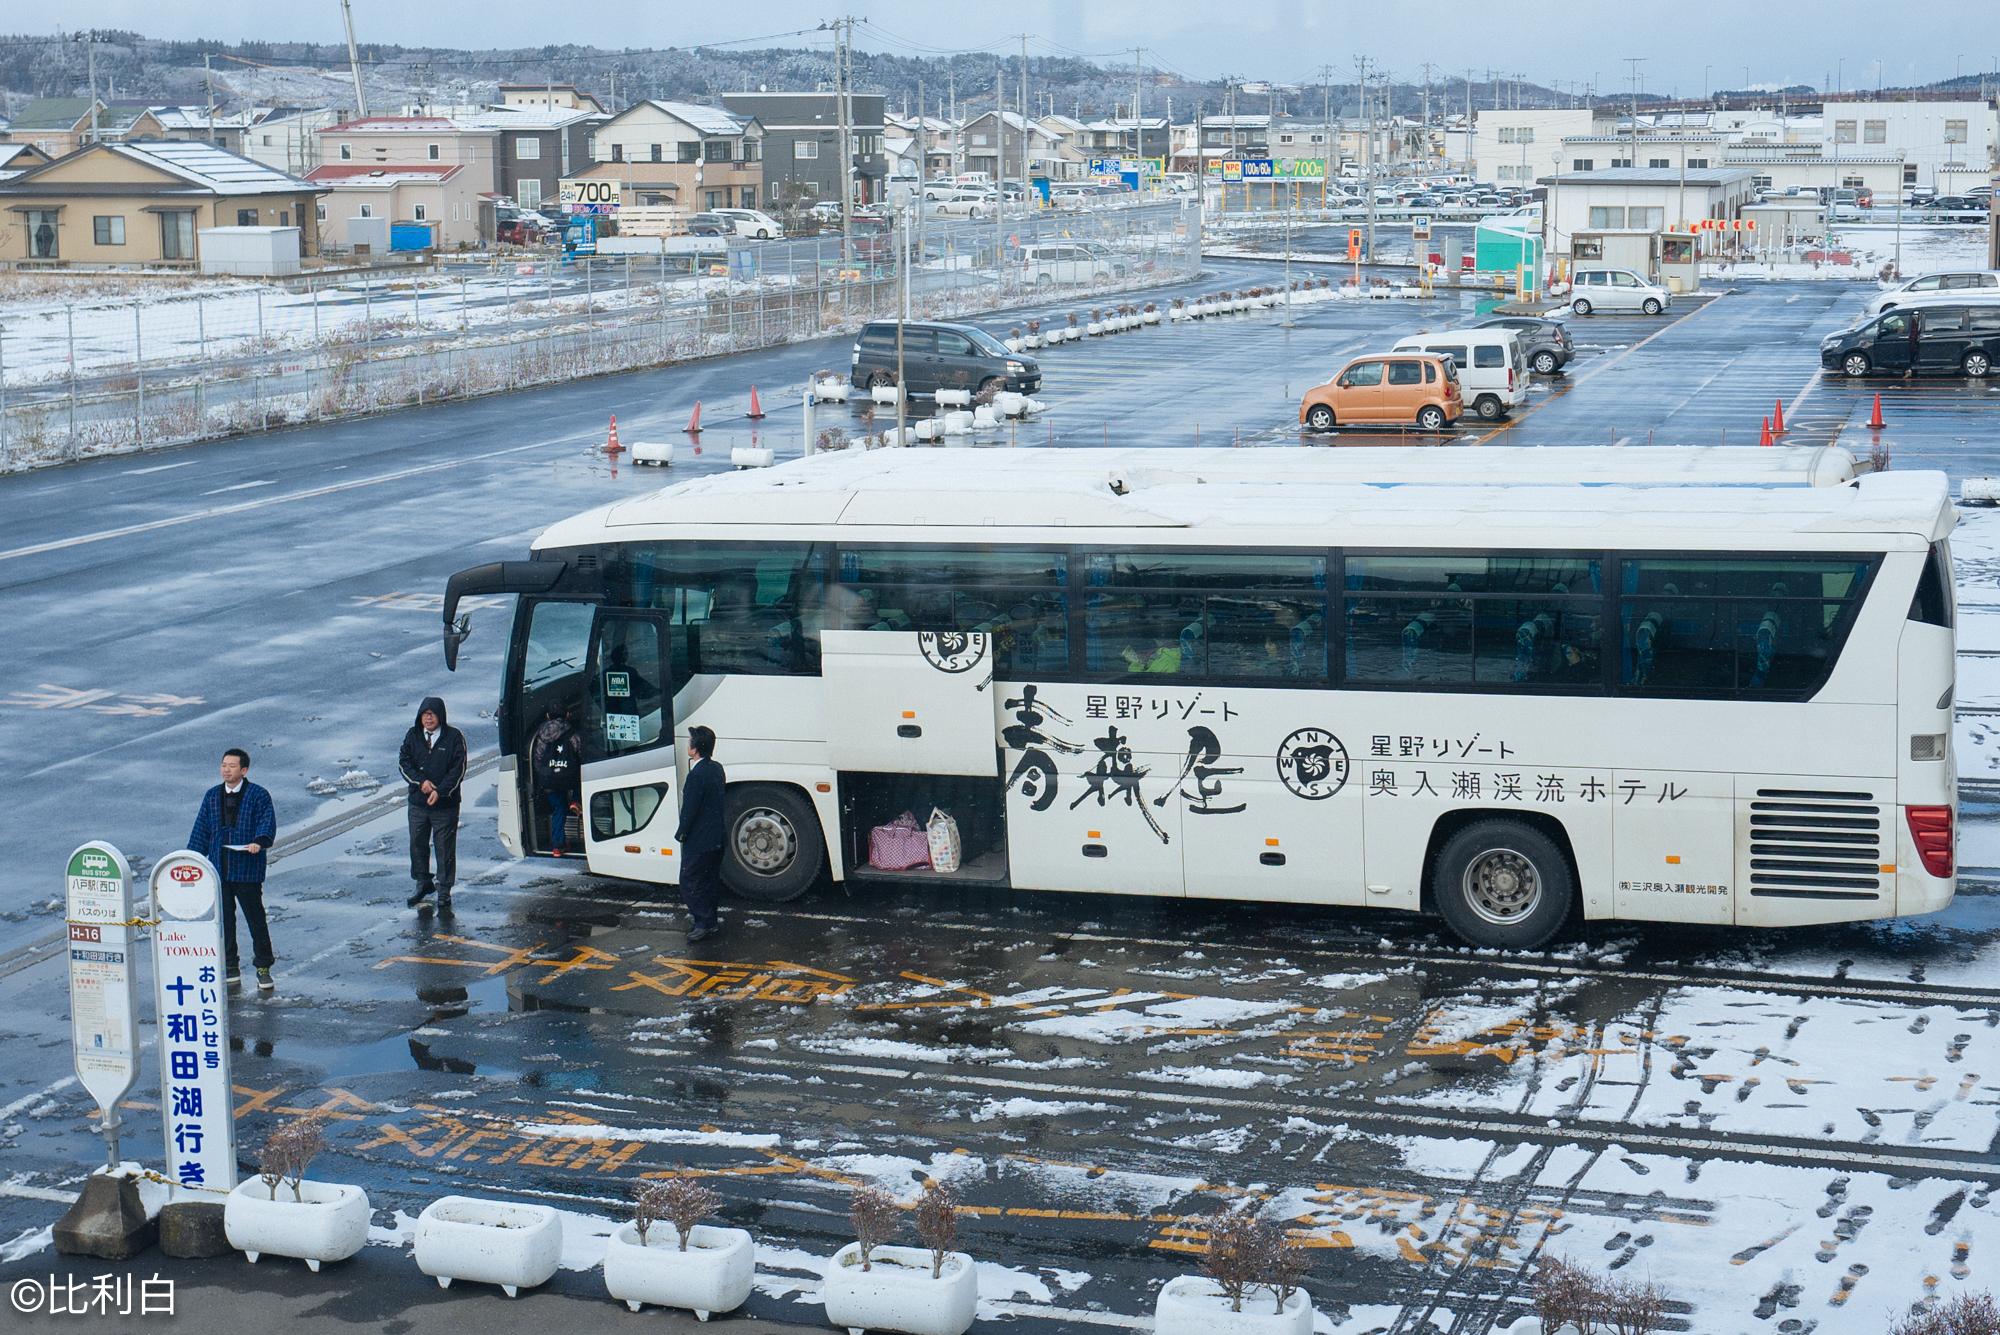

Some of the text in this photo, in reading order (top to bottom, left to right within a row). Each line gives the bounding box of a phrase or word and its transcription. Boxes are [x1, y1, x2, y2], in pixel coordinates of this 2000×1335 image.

[1225, 163, 1240, 172] NPC
[561, 191, 576, 201] 24H
[922, 633, 934, 643] W
[973, 634, 981, 645] E
[950, 657, 958, 669] S
[1086, 692, 1238, 722] 星野リゾート
[1307, 732, 1318, 743] N
[1371, 733, 1515, 759] 星野リゾート
[1002, 684, 1247, 845] 青森屋
[1281, 758, 1293, 768] W
[1335, 760, 1343, 772] E
[1310, 783, 1319, 796] S
[1369, 768, 1688, 805] 奥入瀬渓流ホテル
[71, 927, 99, 940] H-16
[159, 931, 187, 942] Lake
[73, 949, 122, 963] 十和田湖行き
[164, 946, 217, 957] TOWADA
[199, 965, 220, 1069] おいらせ号
[165, 975, 205, 1190] 十和田湖行き
